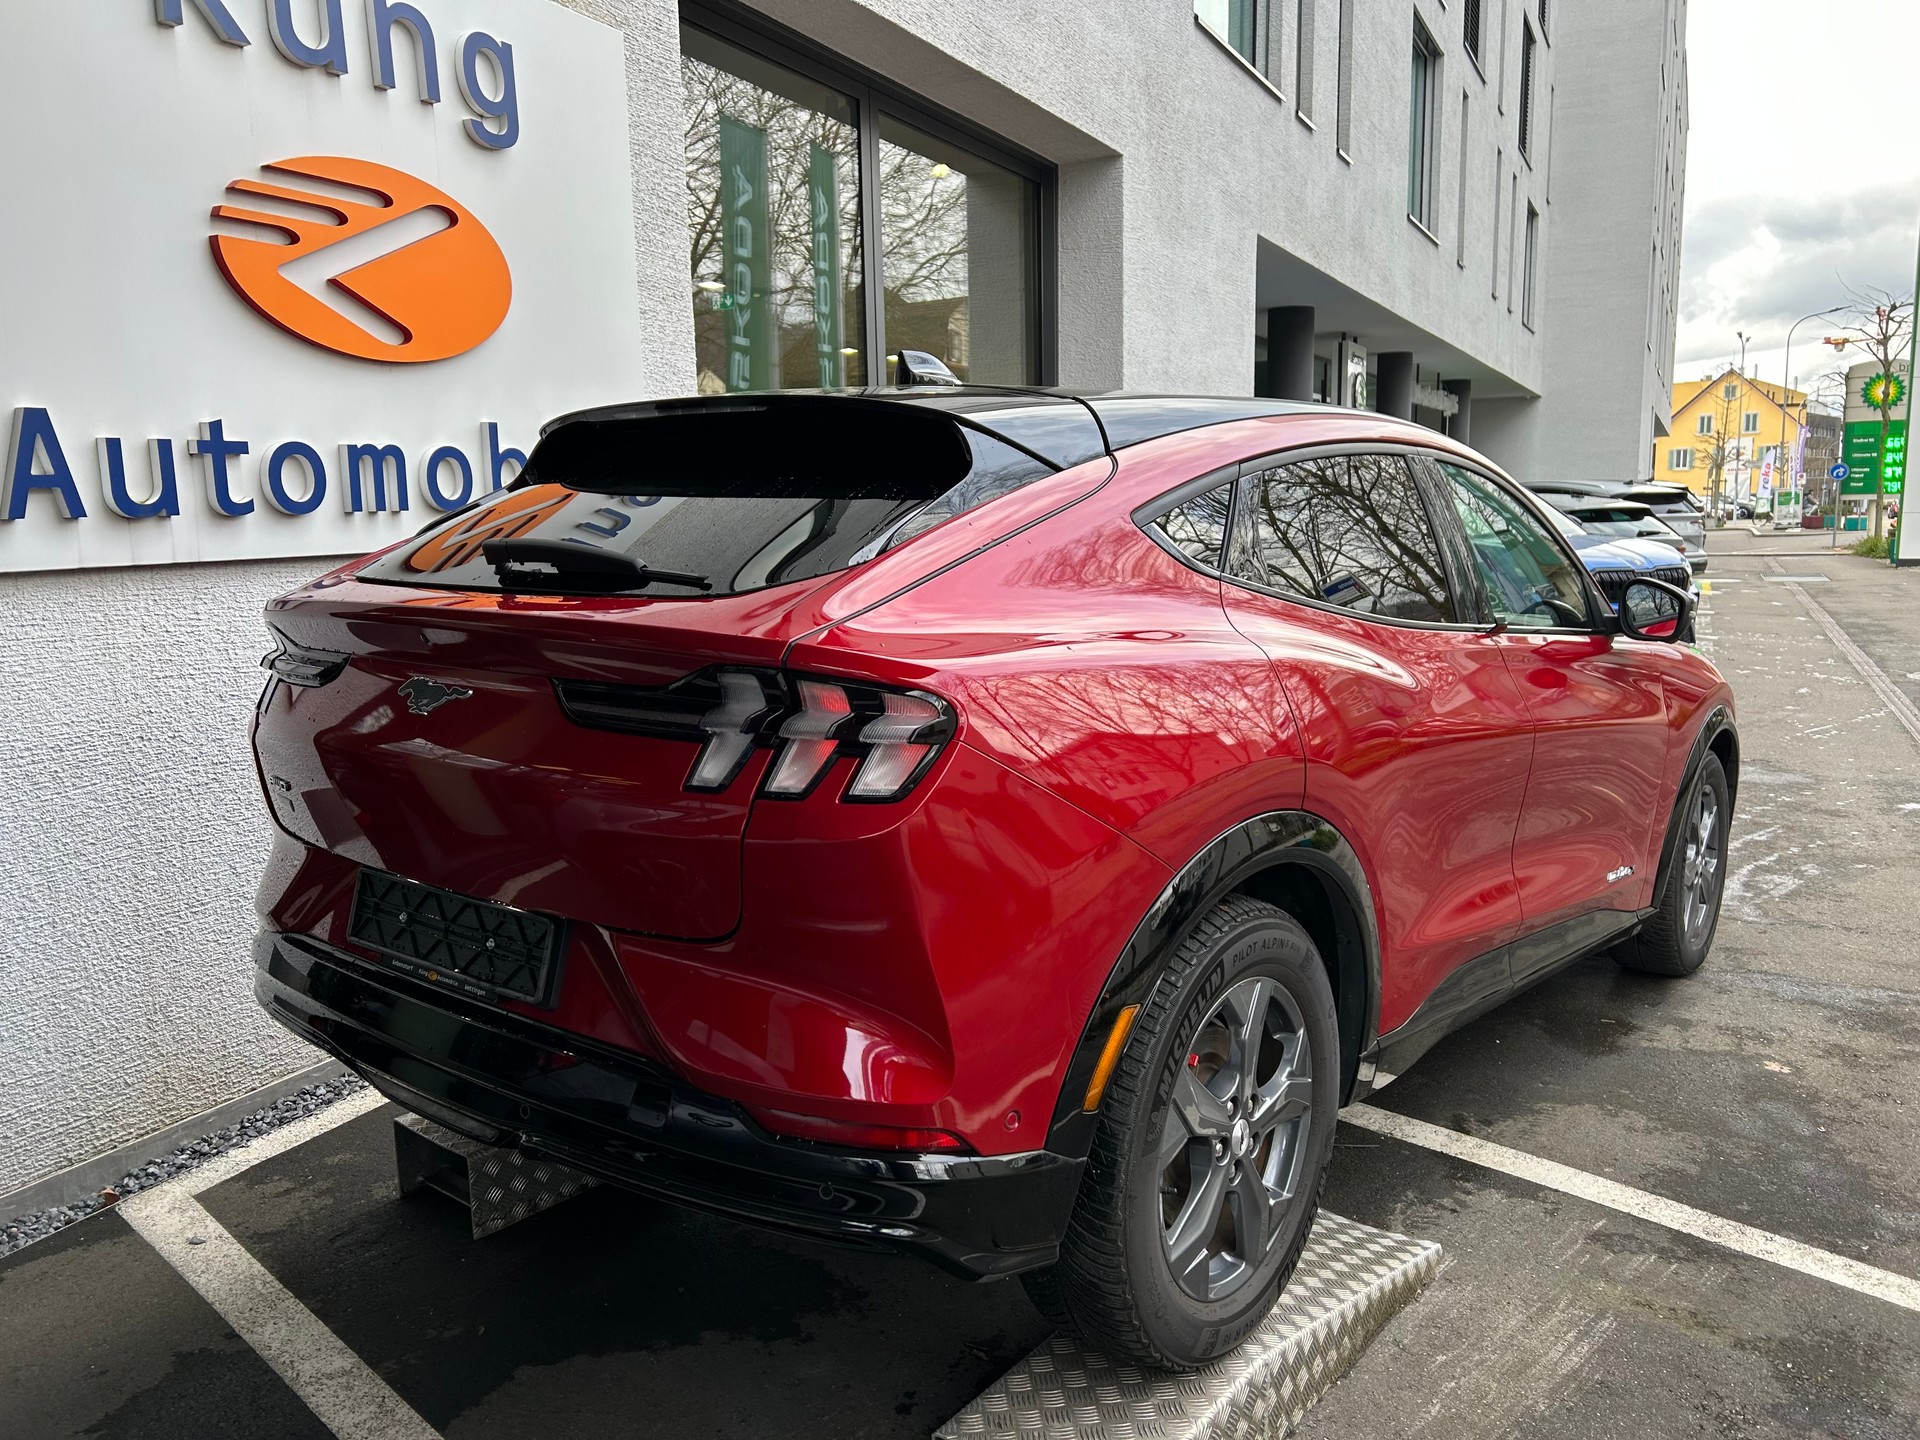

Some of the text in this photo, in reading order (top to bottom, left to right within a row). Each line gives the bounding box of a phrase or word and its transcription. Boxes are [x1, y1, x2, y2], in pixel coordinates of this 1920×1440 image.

[1761, 462, 1772, 491] reka
[1232, 941, 1258, 968] PILOT
[1261, 937, 1286, 952] ALPIN
[1159, 966, 1222, 1101] MICHELIN
